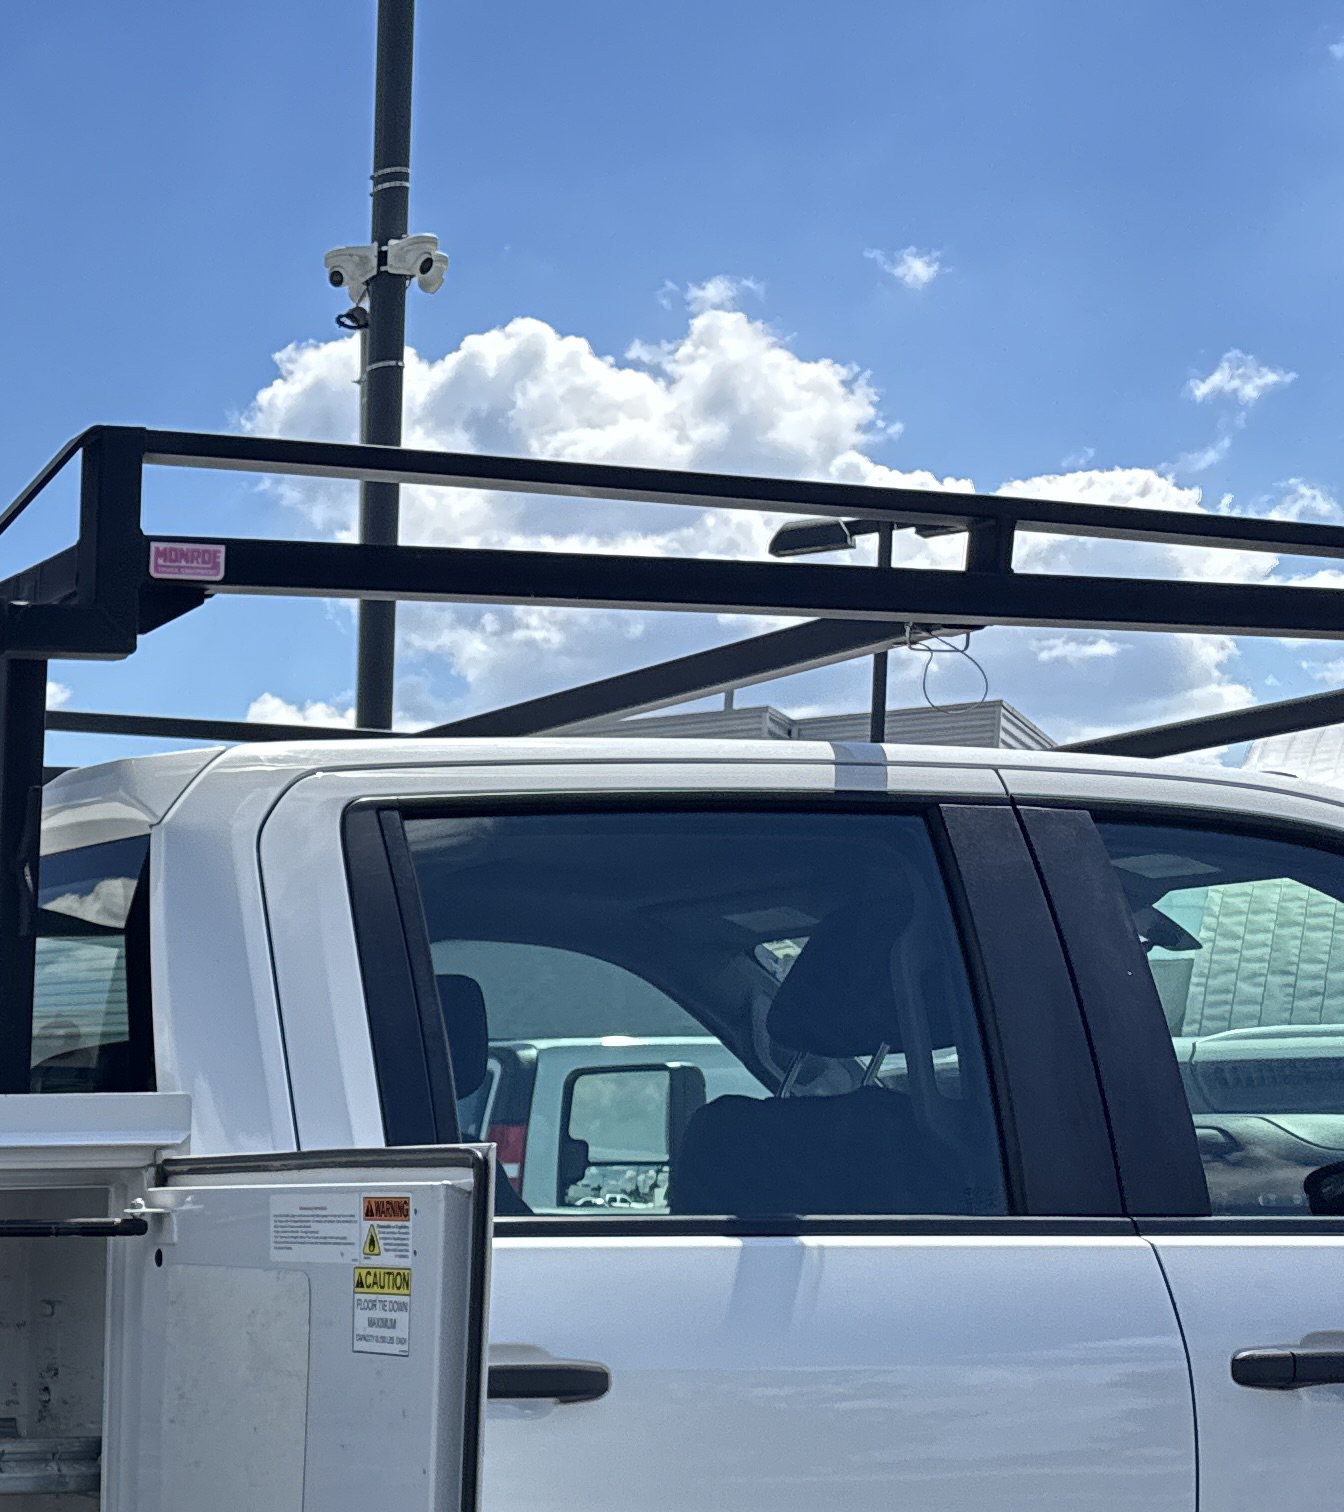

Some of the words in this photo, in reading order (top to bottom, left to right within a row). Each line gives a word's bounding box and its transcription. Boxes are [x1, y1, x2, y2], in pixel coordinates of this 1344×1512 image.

[154, 545, 222, 567] MONROE
[375, 1200, 409, 1218] WARNING
[365, 1271, 409, 1291] CAUTION
